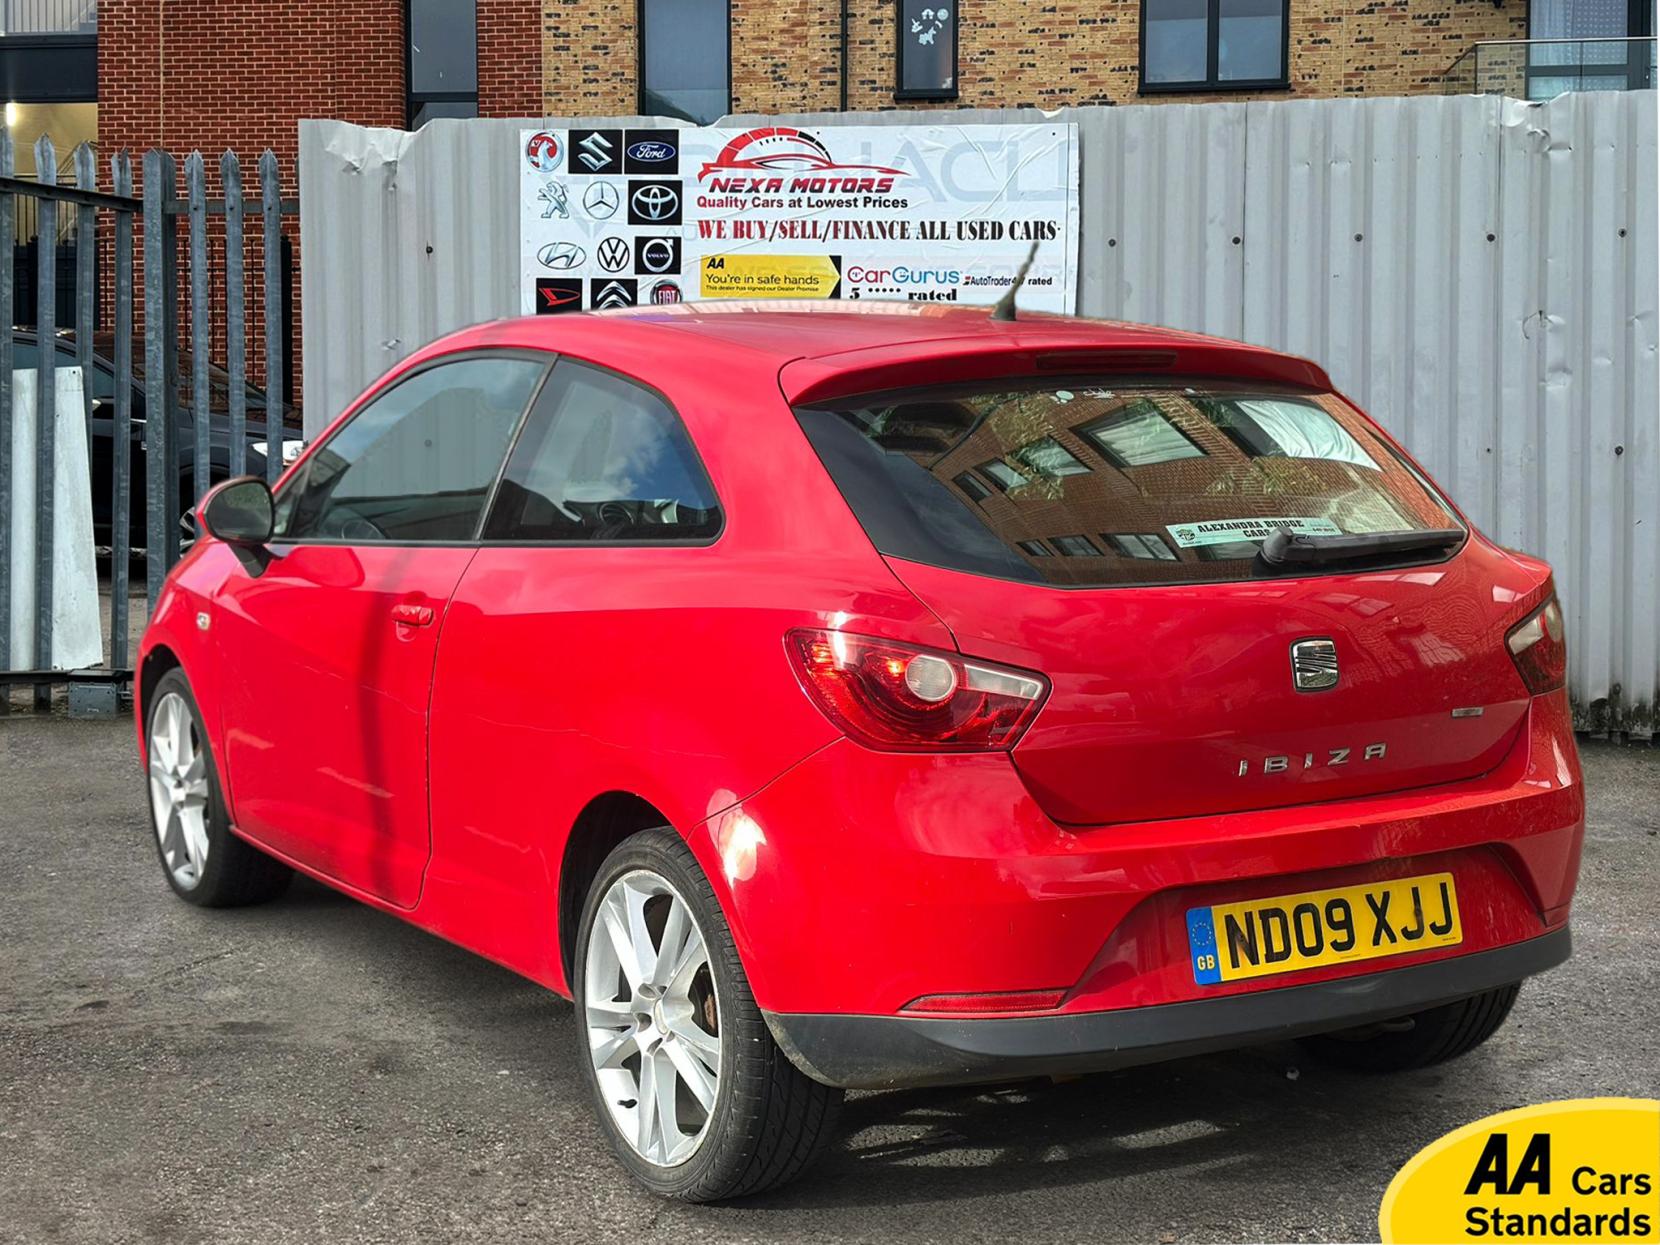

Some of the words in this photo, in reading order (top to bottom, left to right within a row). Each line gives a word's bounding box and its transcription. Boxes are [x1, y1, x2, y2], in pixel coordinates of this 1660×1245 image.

[636, 144, 666, 159] Ford
[709, 177, 783, 193] NEXA
[789, 177, 895, 193] MOTORS
[697, 196, 747, 210] Quality
[751, 196, 784, 208] Cars
[788, 197, 802, 208] at
[807, 196, 859, 208] Lowest
[863, 196, 908, 208] Prices
[697, 220, 726, 240] WE
[733, 219, 911, 243] BUY/SELL/FINANCE
[916, 220, 950, 240] ALL
[956, 220, 1003, 240] USED
[706, 257, 724, 270] AA
[706, 273, 741, 284] You're
[744, 274, 754, 284] in
[757, 274, 781, 285] safe
[784, 274, 820, 285] hands
[847, 265, 960, 284] CarGurus
[970, 275, 1011, 286] AutoTrader
[1028, 276, 1053, 286] rated
[849, 287, 860, 300] 5
[908, 288, 957, 301] rated
[1197, 520, 1262, 533] ALEXANDRA
[1264, 519, 1305, 528] BRIDGE
[1238, 742, 1387, 777] IBIZA
[1224, 897, 1356, 969] ND09
[1365, 882, 1453, 947] XJJ
[1197, 954, 1215, 970] GB
